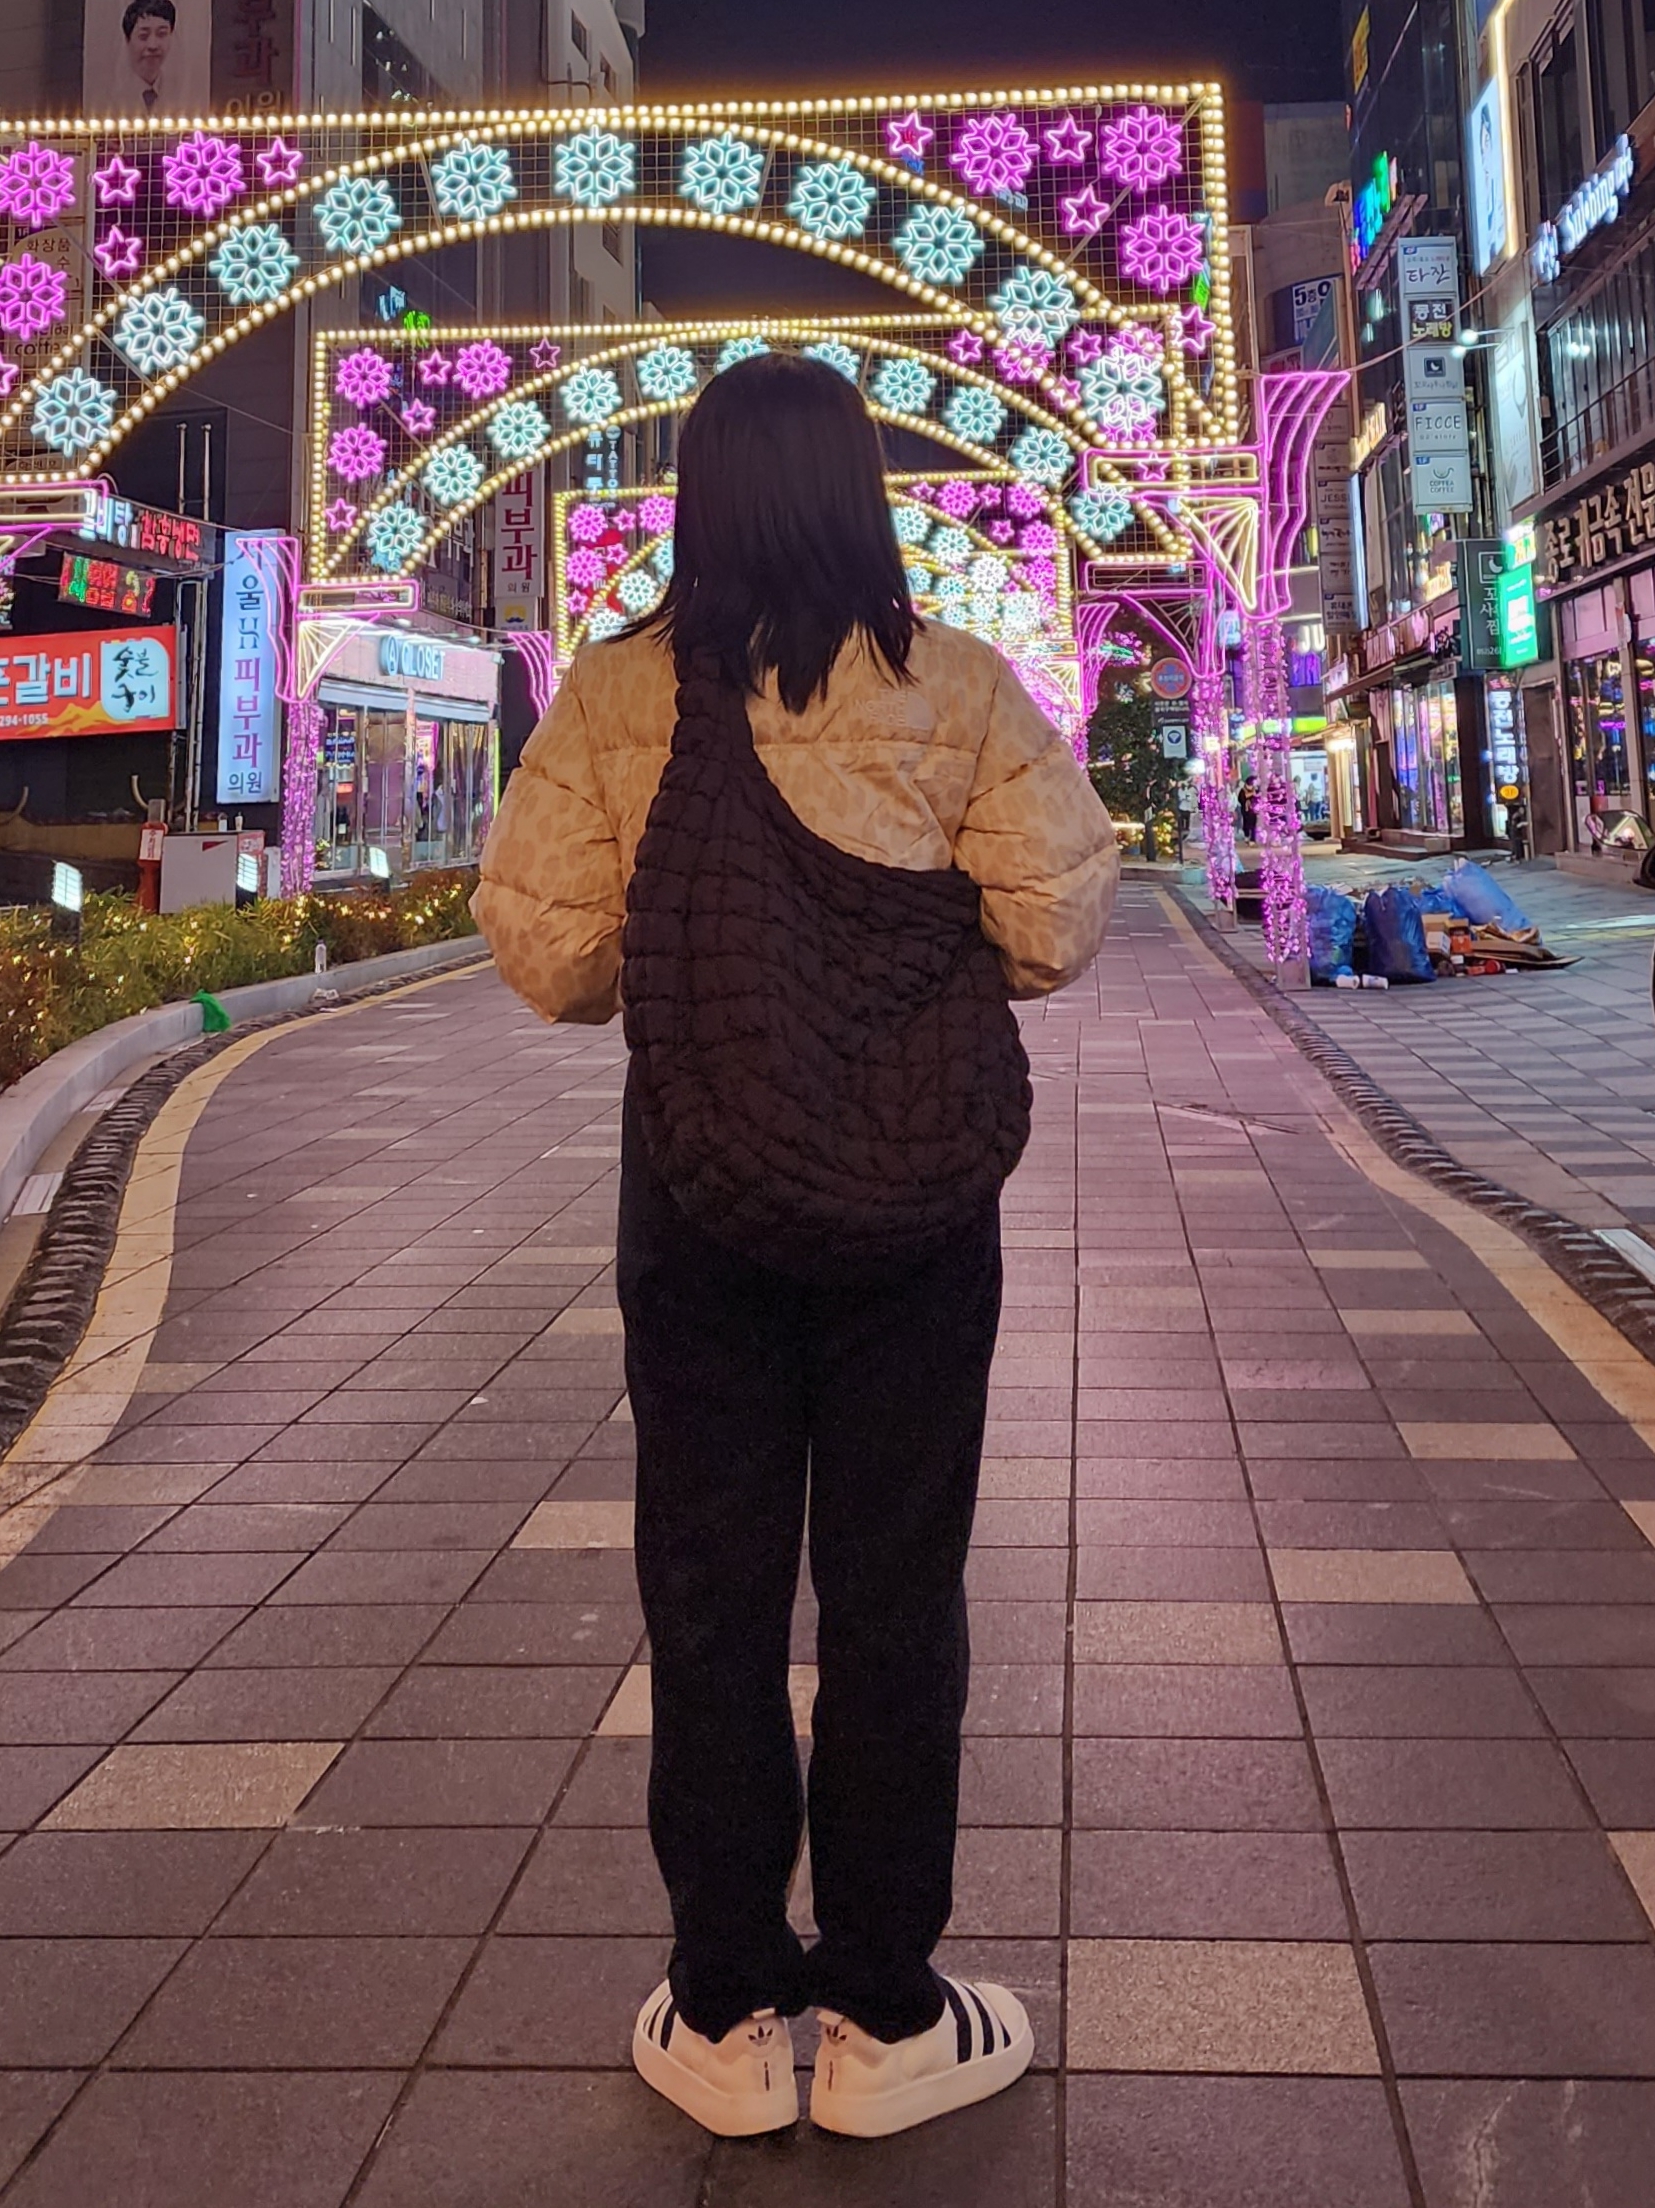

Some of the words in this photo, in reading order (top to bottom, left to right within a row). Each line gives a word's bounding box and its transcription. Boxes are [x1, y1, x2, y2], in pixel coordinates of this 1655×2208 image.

[1412, 321, 1453, 338] 노래방
[1415, 415, 1461, 431] FICCE
[500, 472, 538, 580] 피부과
[402, 641, 446, 681] CLOSET
[111, 683, 156, 713] 구이
[227, 771, 263, 794] 의원
